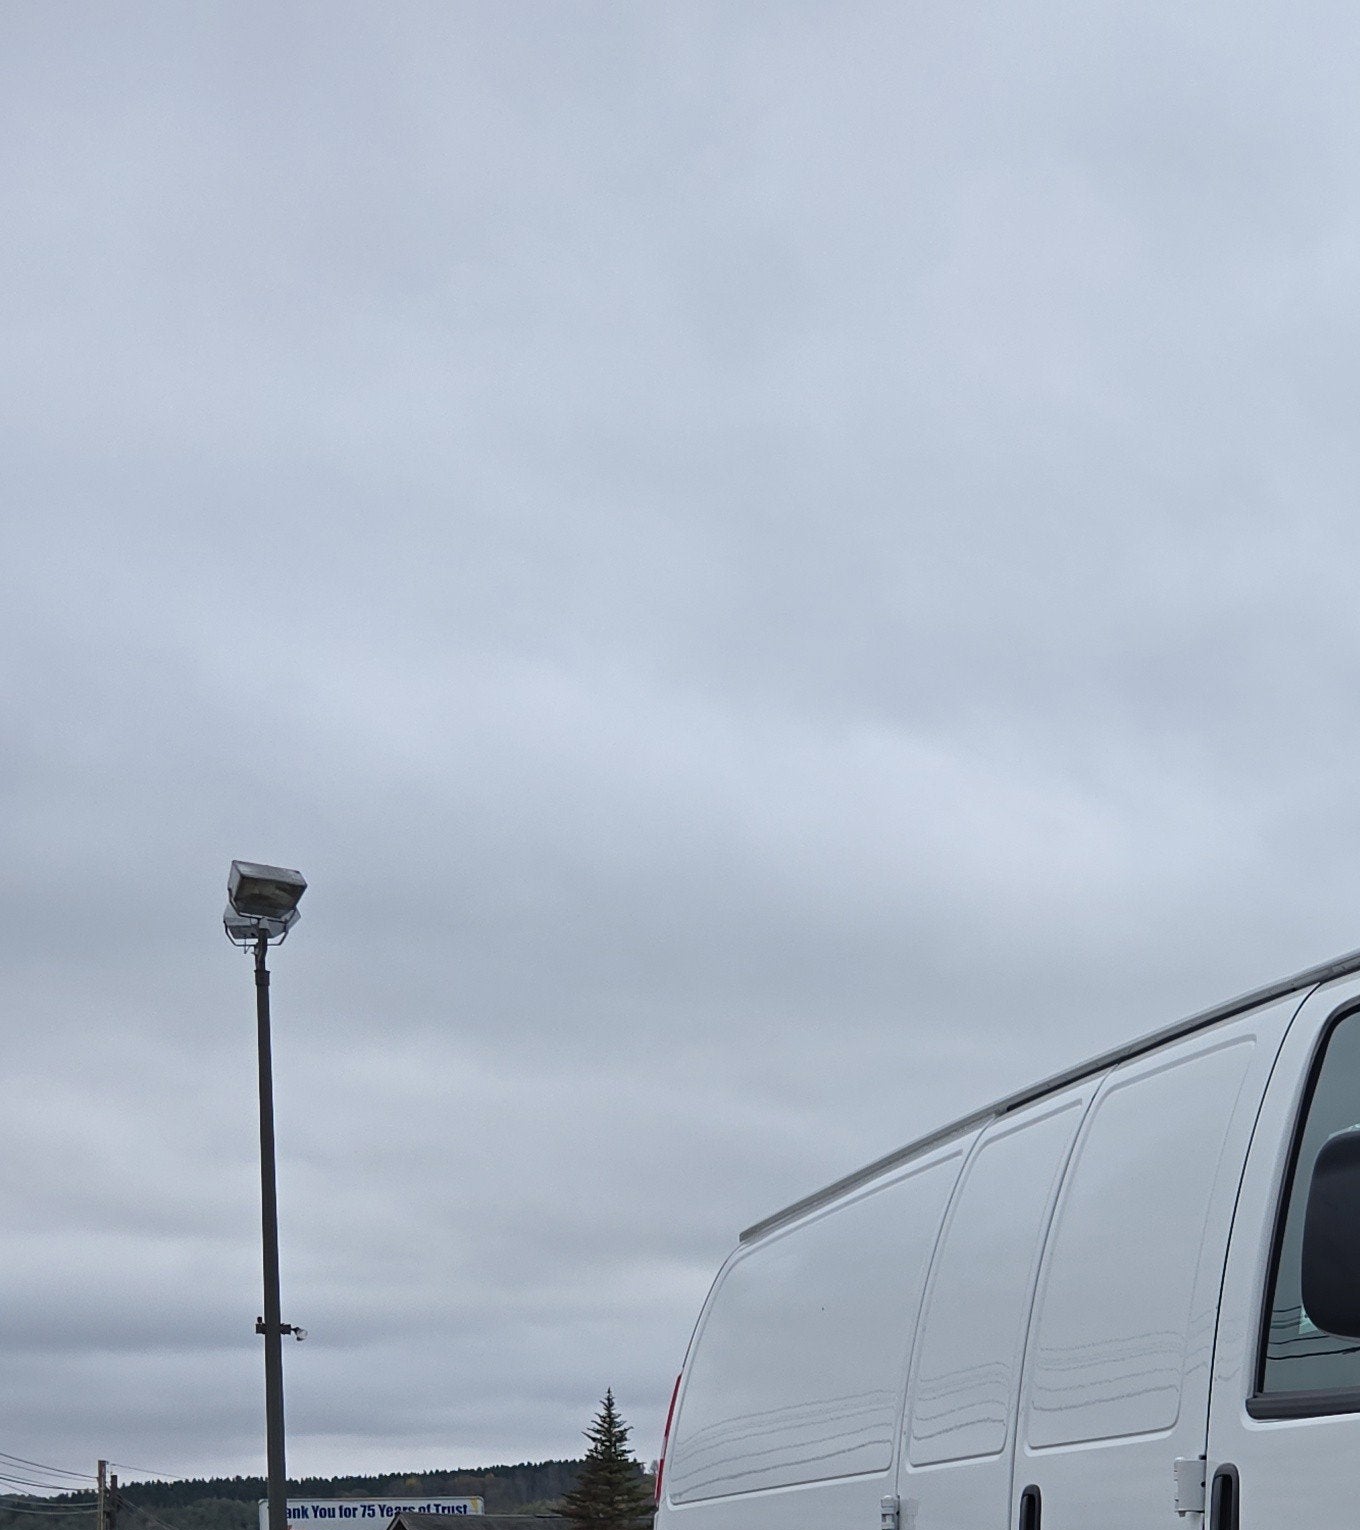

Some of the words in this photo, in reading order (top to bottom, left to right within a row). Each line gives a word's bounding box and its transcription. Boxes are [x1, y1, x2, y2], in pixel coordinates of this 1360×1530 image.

[286, 1505, 310, 1519] ank
[311, 1505, 336, 1519] You
[339, 1504, 358, 1519] for
[360, 1504, 376, 1518] 75
[433, 1503, 468, 1514] Trust
